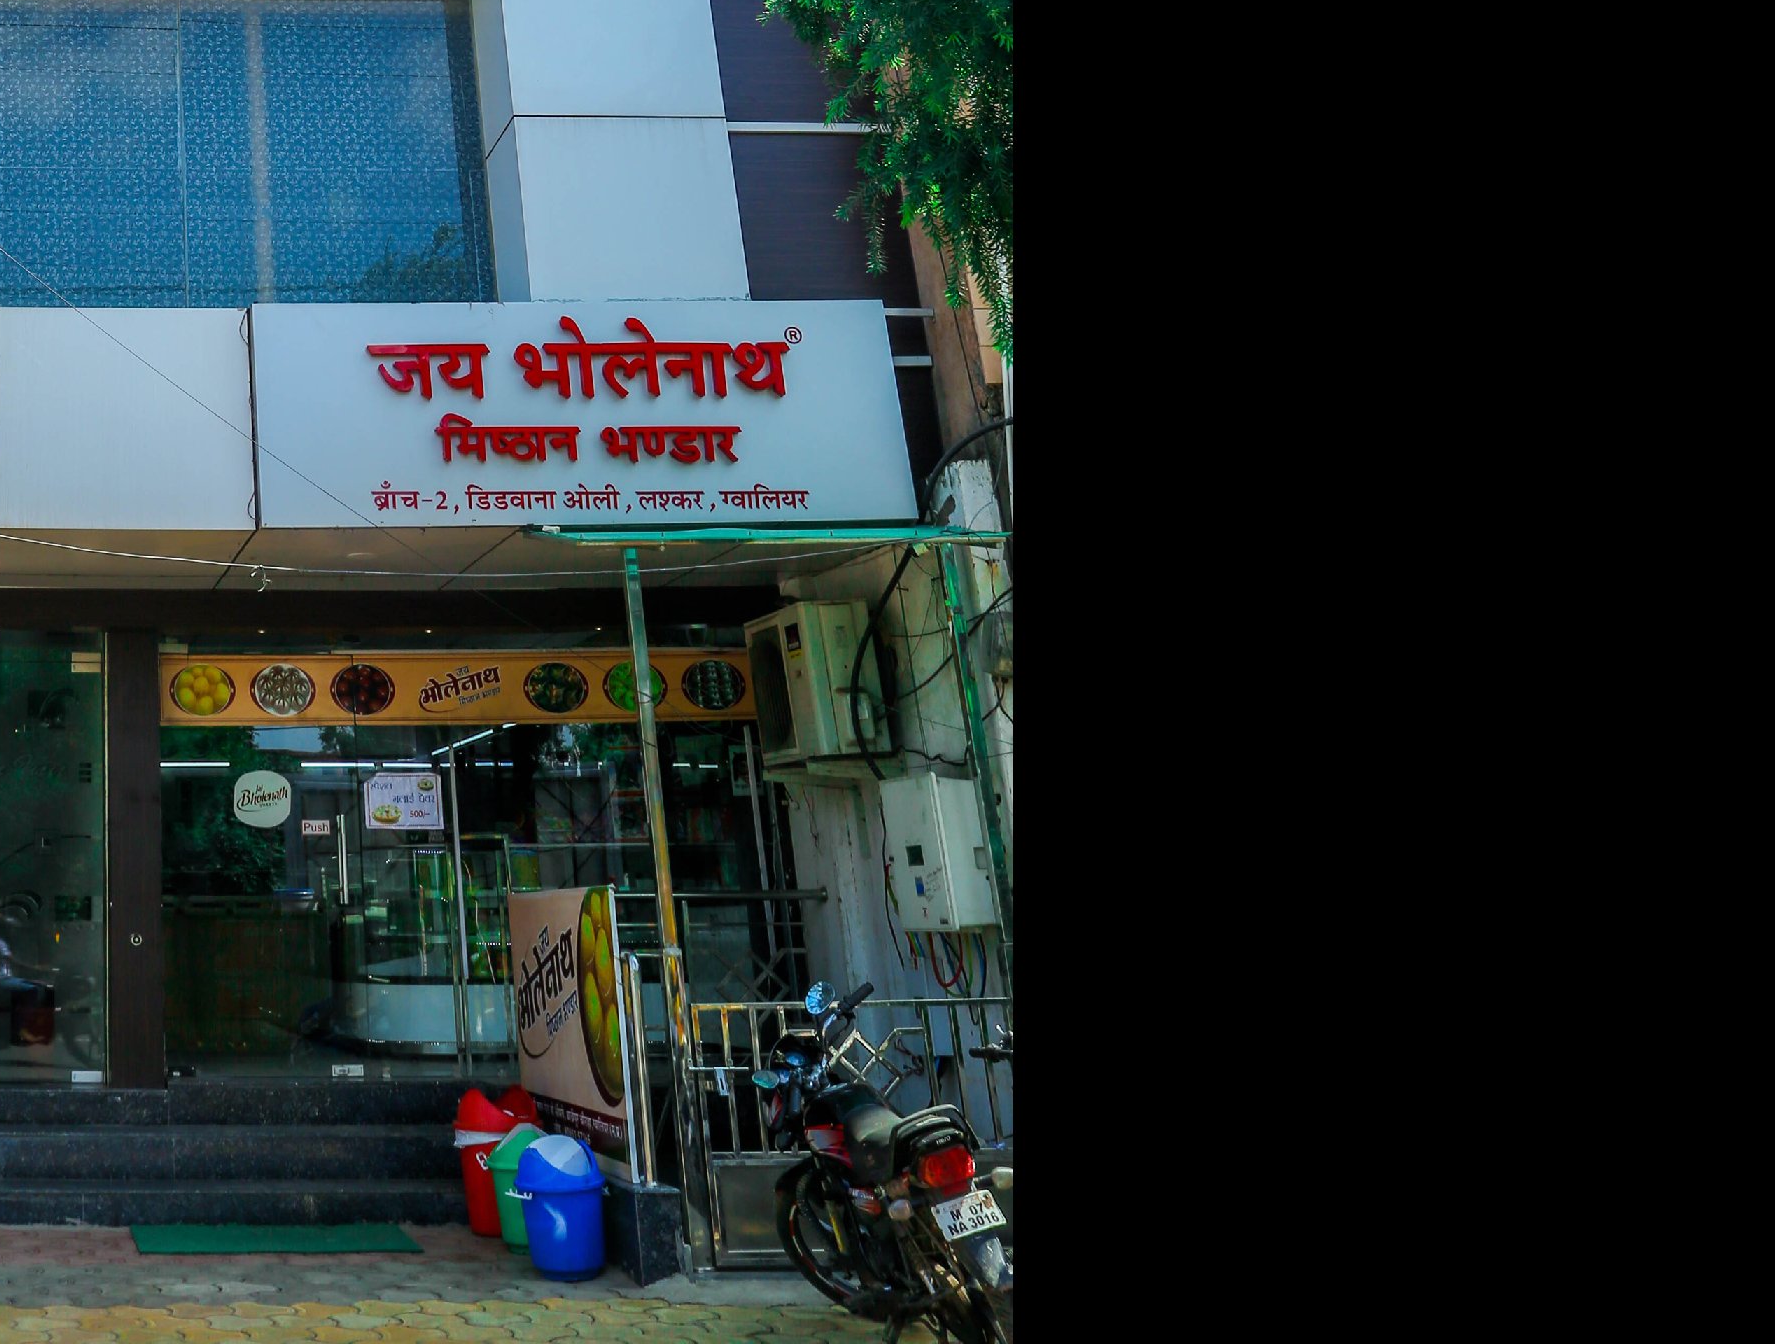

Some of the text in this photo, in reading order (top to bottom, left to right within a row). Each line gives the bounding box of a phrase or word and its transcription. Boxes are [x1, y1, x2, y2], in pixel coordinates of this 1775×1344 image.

[366, 342, 491, 400] जय
[513, 315, 791, 400] भोलेनाथ
[434, 412, 743, 463] मिष्ठान भण्डार
[465, 483, 558, 512] डिडवाना
[717, 483, 811, 512] ग्वालियर
[420, 664, 501, 704] भोलेनाथ
[303, 822, 329, 833] Push
[517, 926, 575, 1030] भोलेनाथ
